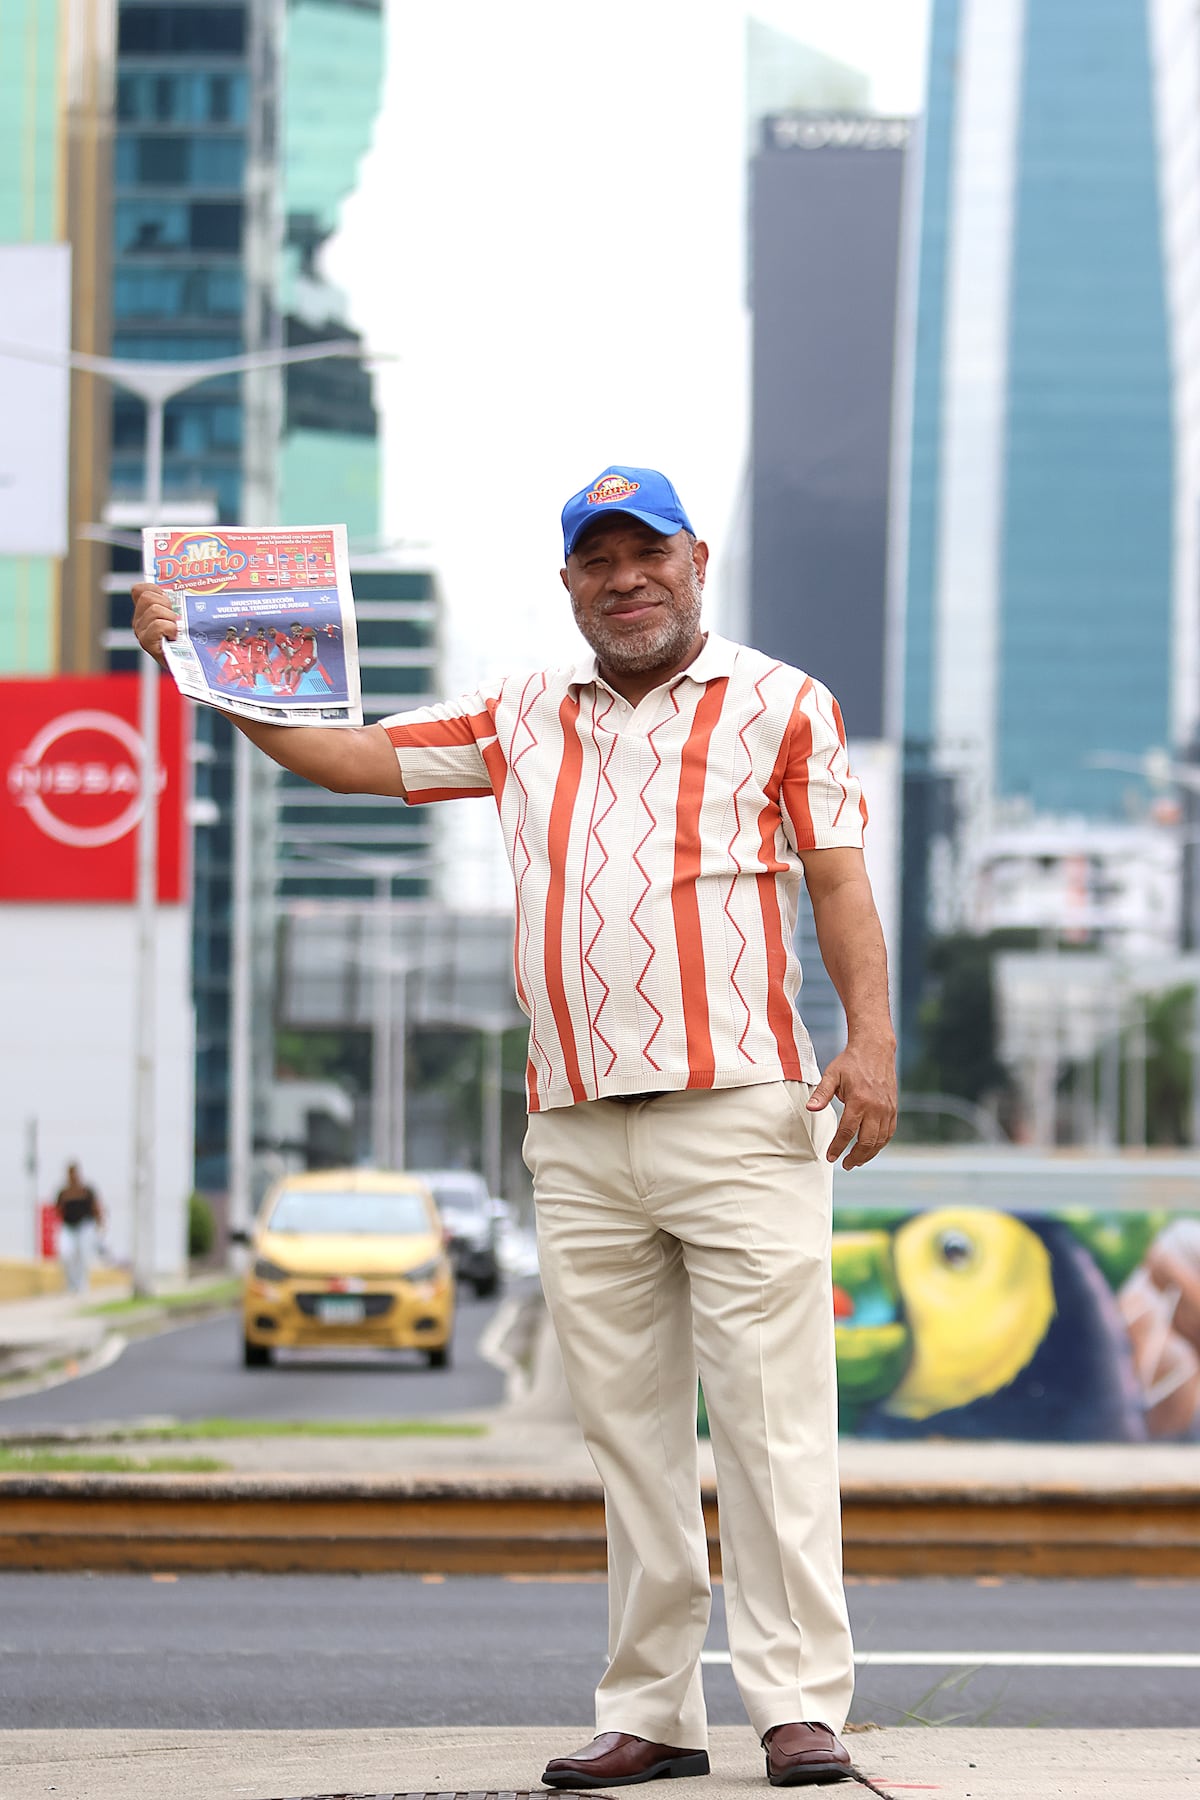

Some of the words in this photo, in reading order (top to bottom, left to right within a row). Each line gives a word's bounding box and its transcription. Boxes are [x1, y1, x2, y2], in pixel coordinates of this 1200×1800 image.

[587, 482, 640, 504] Diario
[186, 541, 220, 561] Mi
[157, 548, 244, 582] Diario
[207, 575, 238, 585] Panamá
[250, 603, 279, 611] TERRENO
